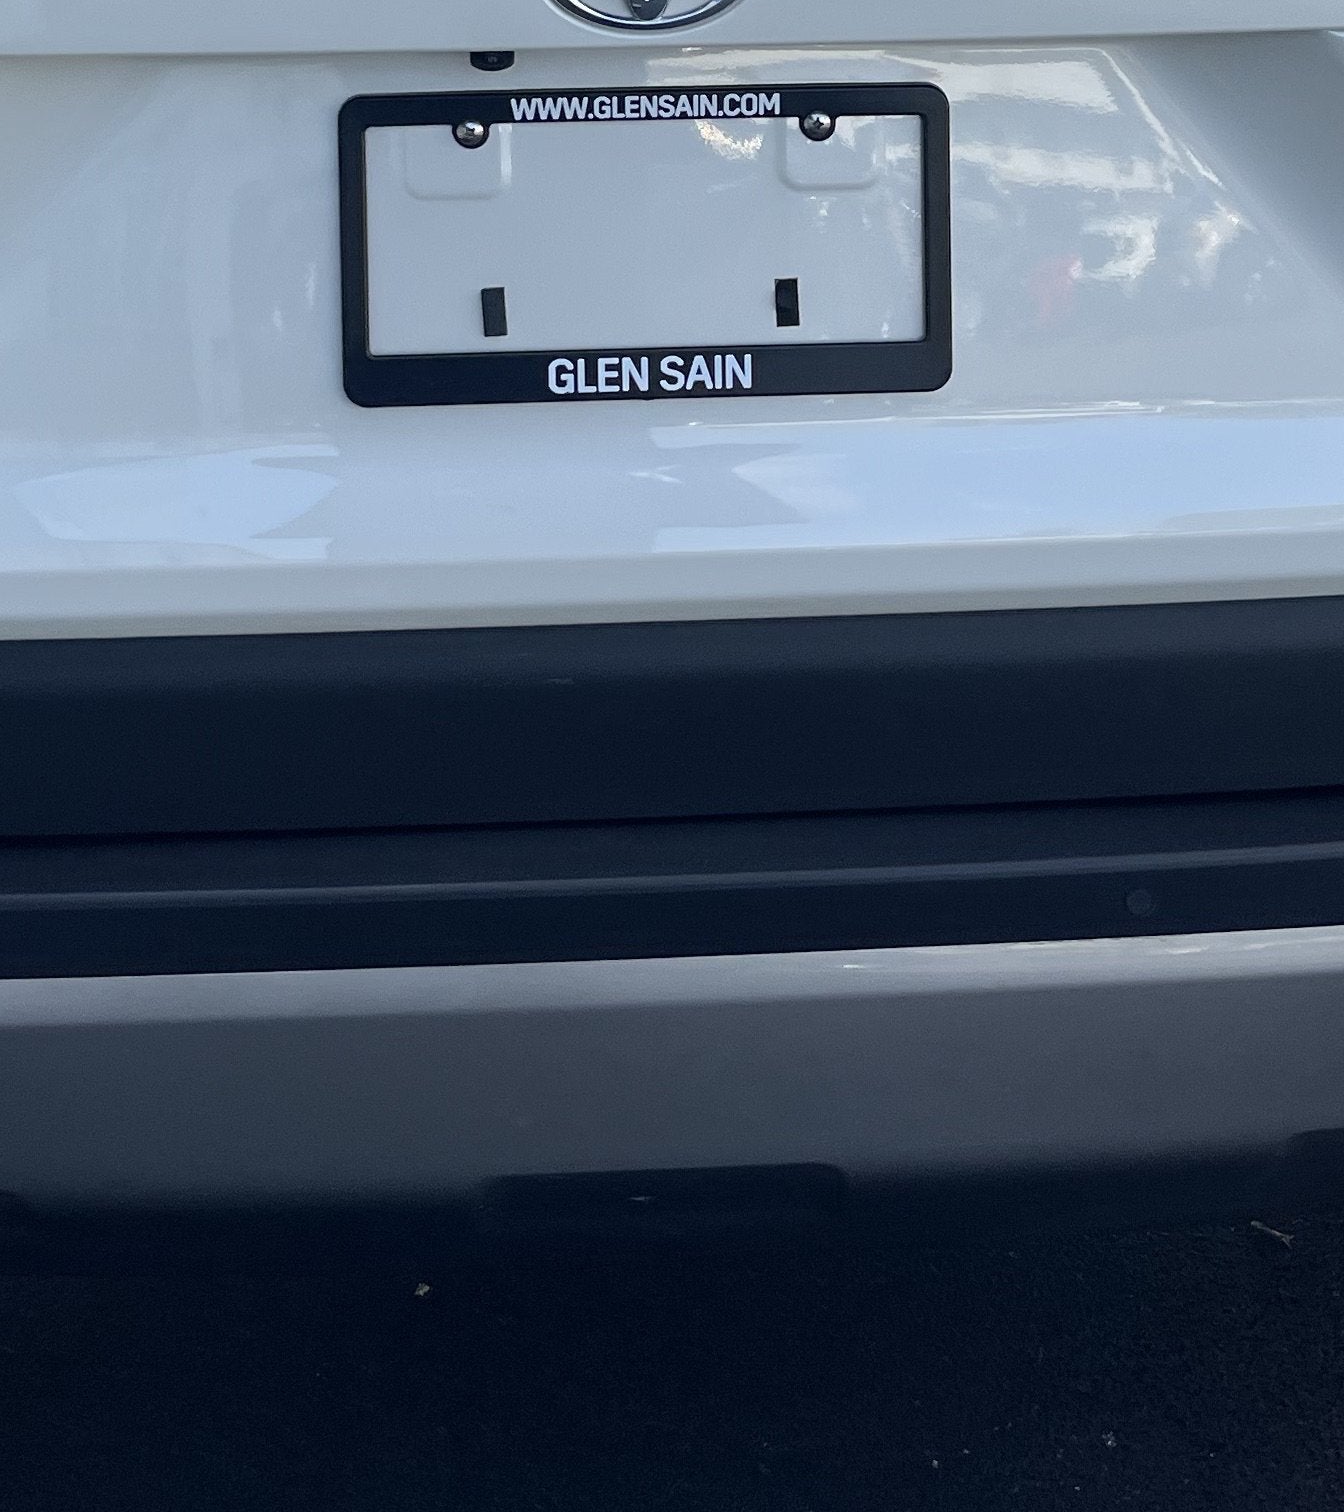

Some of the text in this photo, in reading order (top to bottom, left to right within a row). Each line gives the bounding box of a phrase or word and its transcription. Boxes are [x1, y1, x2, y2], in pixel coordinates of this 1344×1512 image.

[511, 93, 781, 121] WWW.GLENSAIN.COM
[547, 353, 753, 394] GLEN SAIN
